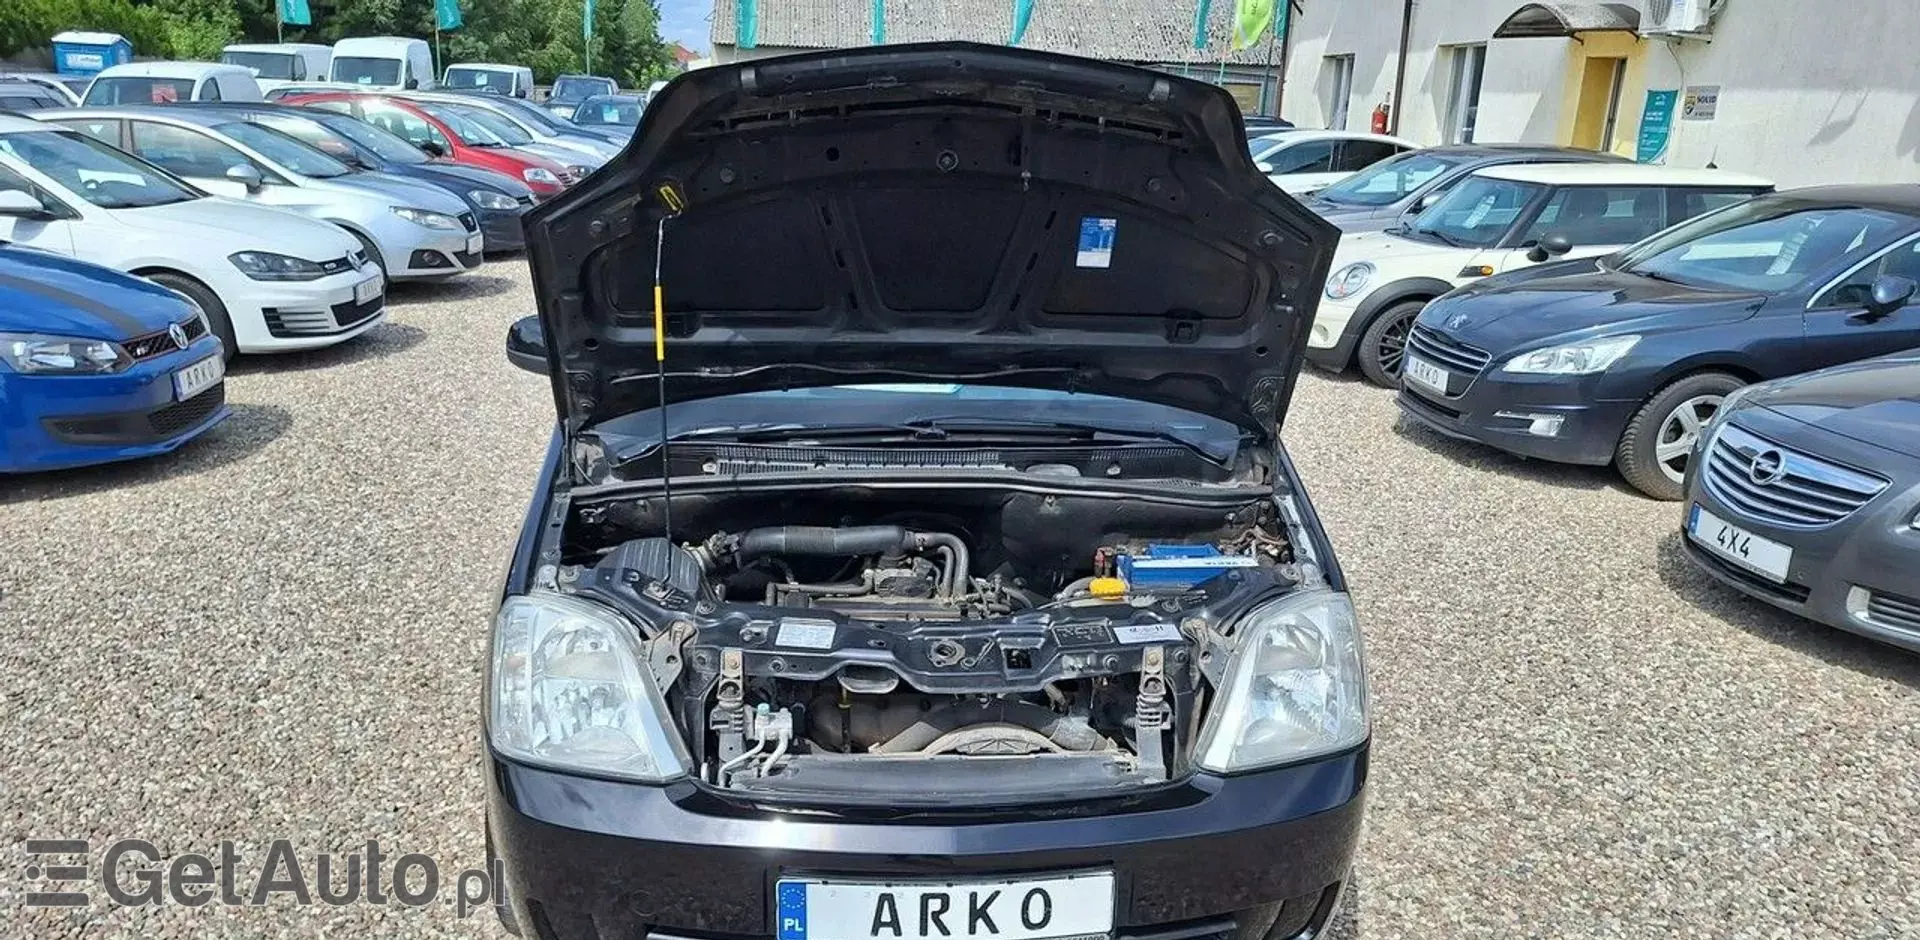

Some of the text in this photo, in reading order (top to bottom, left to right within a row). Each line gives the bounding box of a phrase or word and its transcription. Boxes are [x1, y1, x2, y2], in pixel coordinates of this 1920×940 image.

[186, 360, 215, 390] ARKO
[1717, 526, 1750, 558] 4X4
[784, 918, 804, 931] PL
[870, 887, 1053, 937] ARKO
